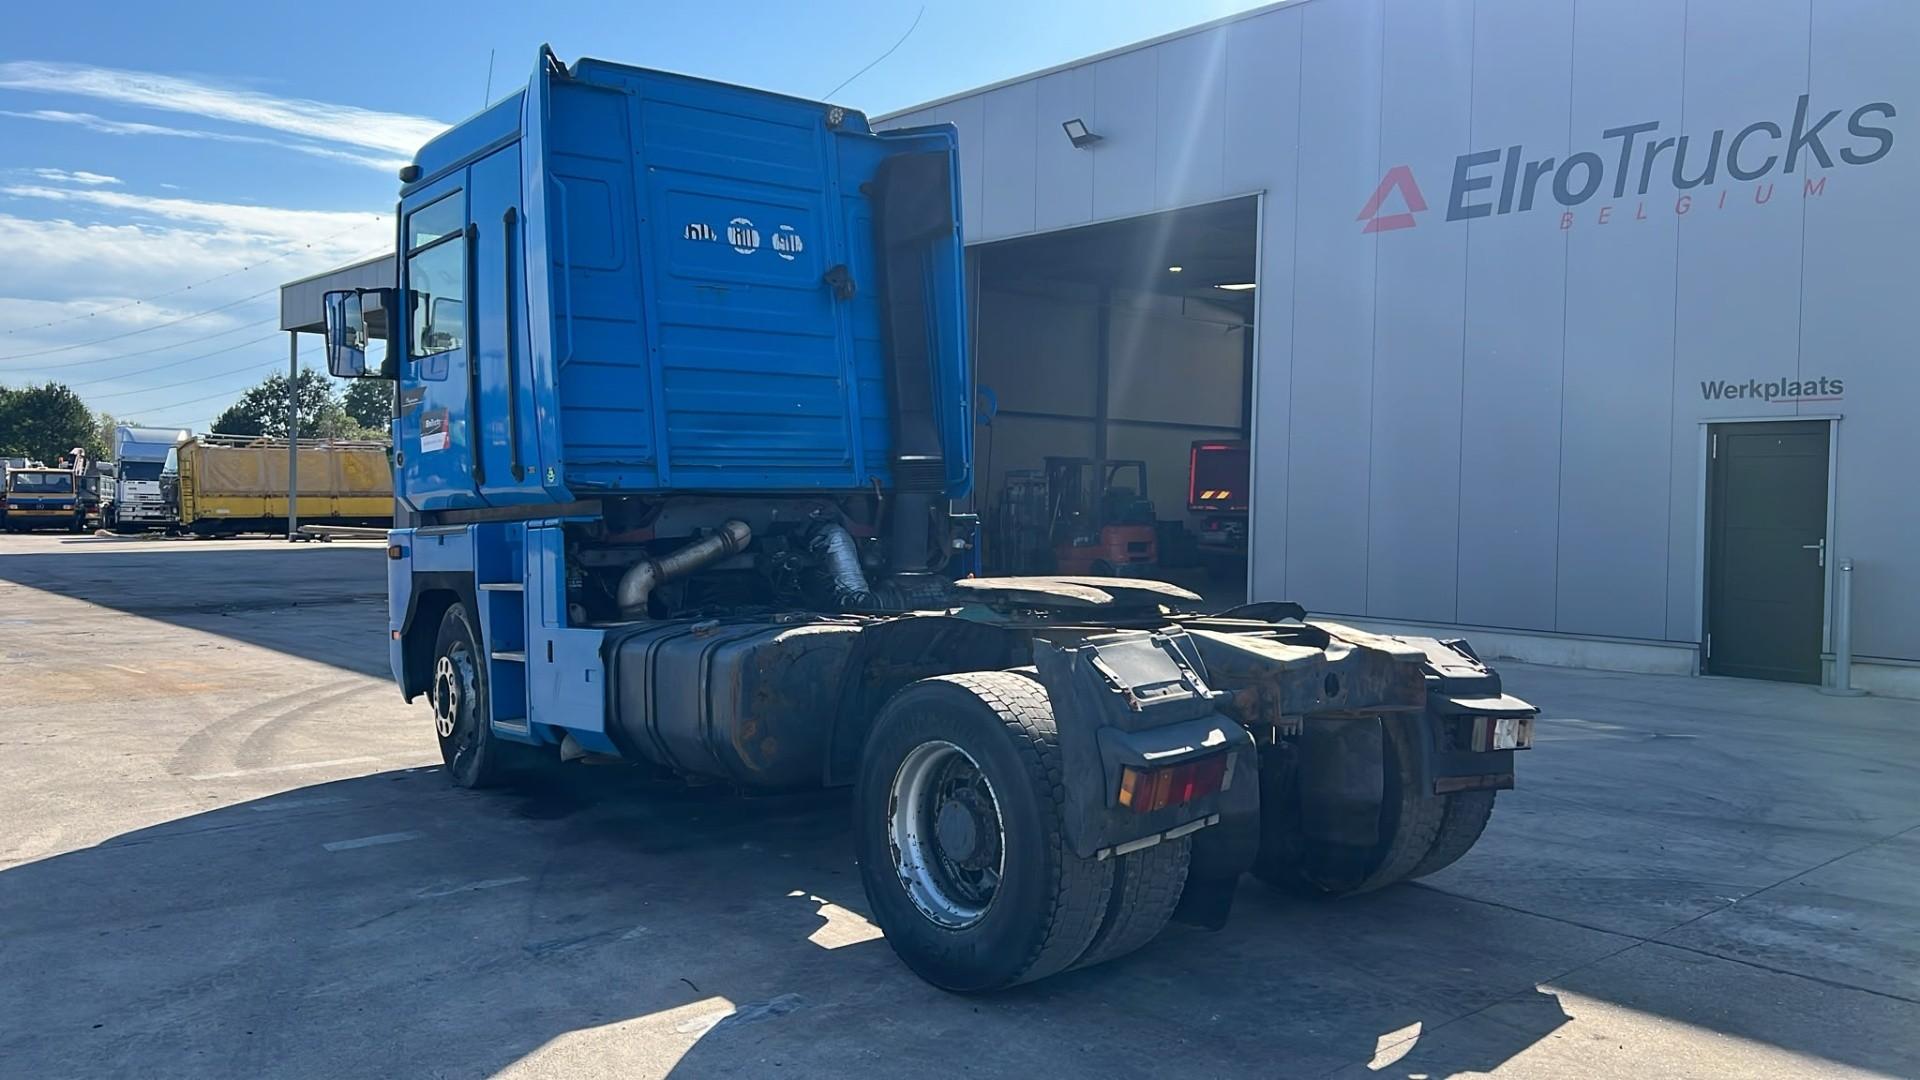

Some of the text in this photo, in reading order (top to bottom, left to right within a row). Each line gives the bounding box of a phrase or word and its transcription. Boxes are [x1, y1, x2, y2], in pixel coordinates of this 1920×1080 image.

[1446, 94, 1897, 222] ElroTrucks
[1560, 176, 1827, 230] BELGIUM
[1701, 376, 1844, 401] Werkplaats
